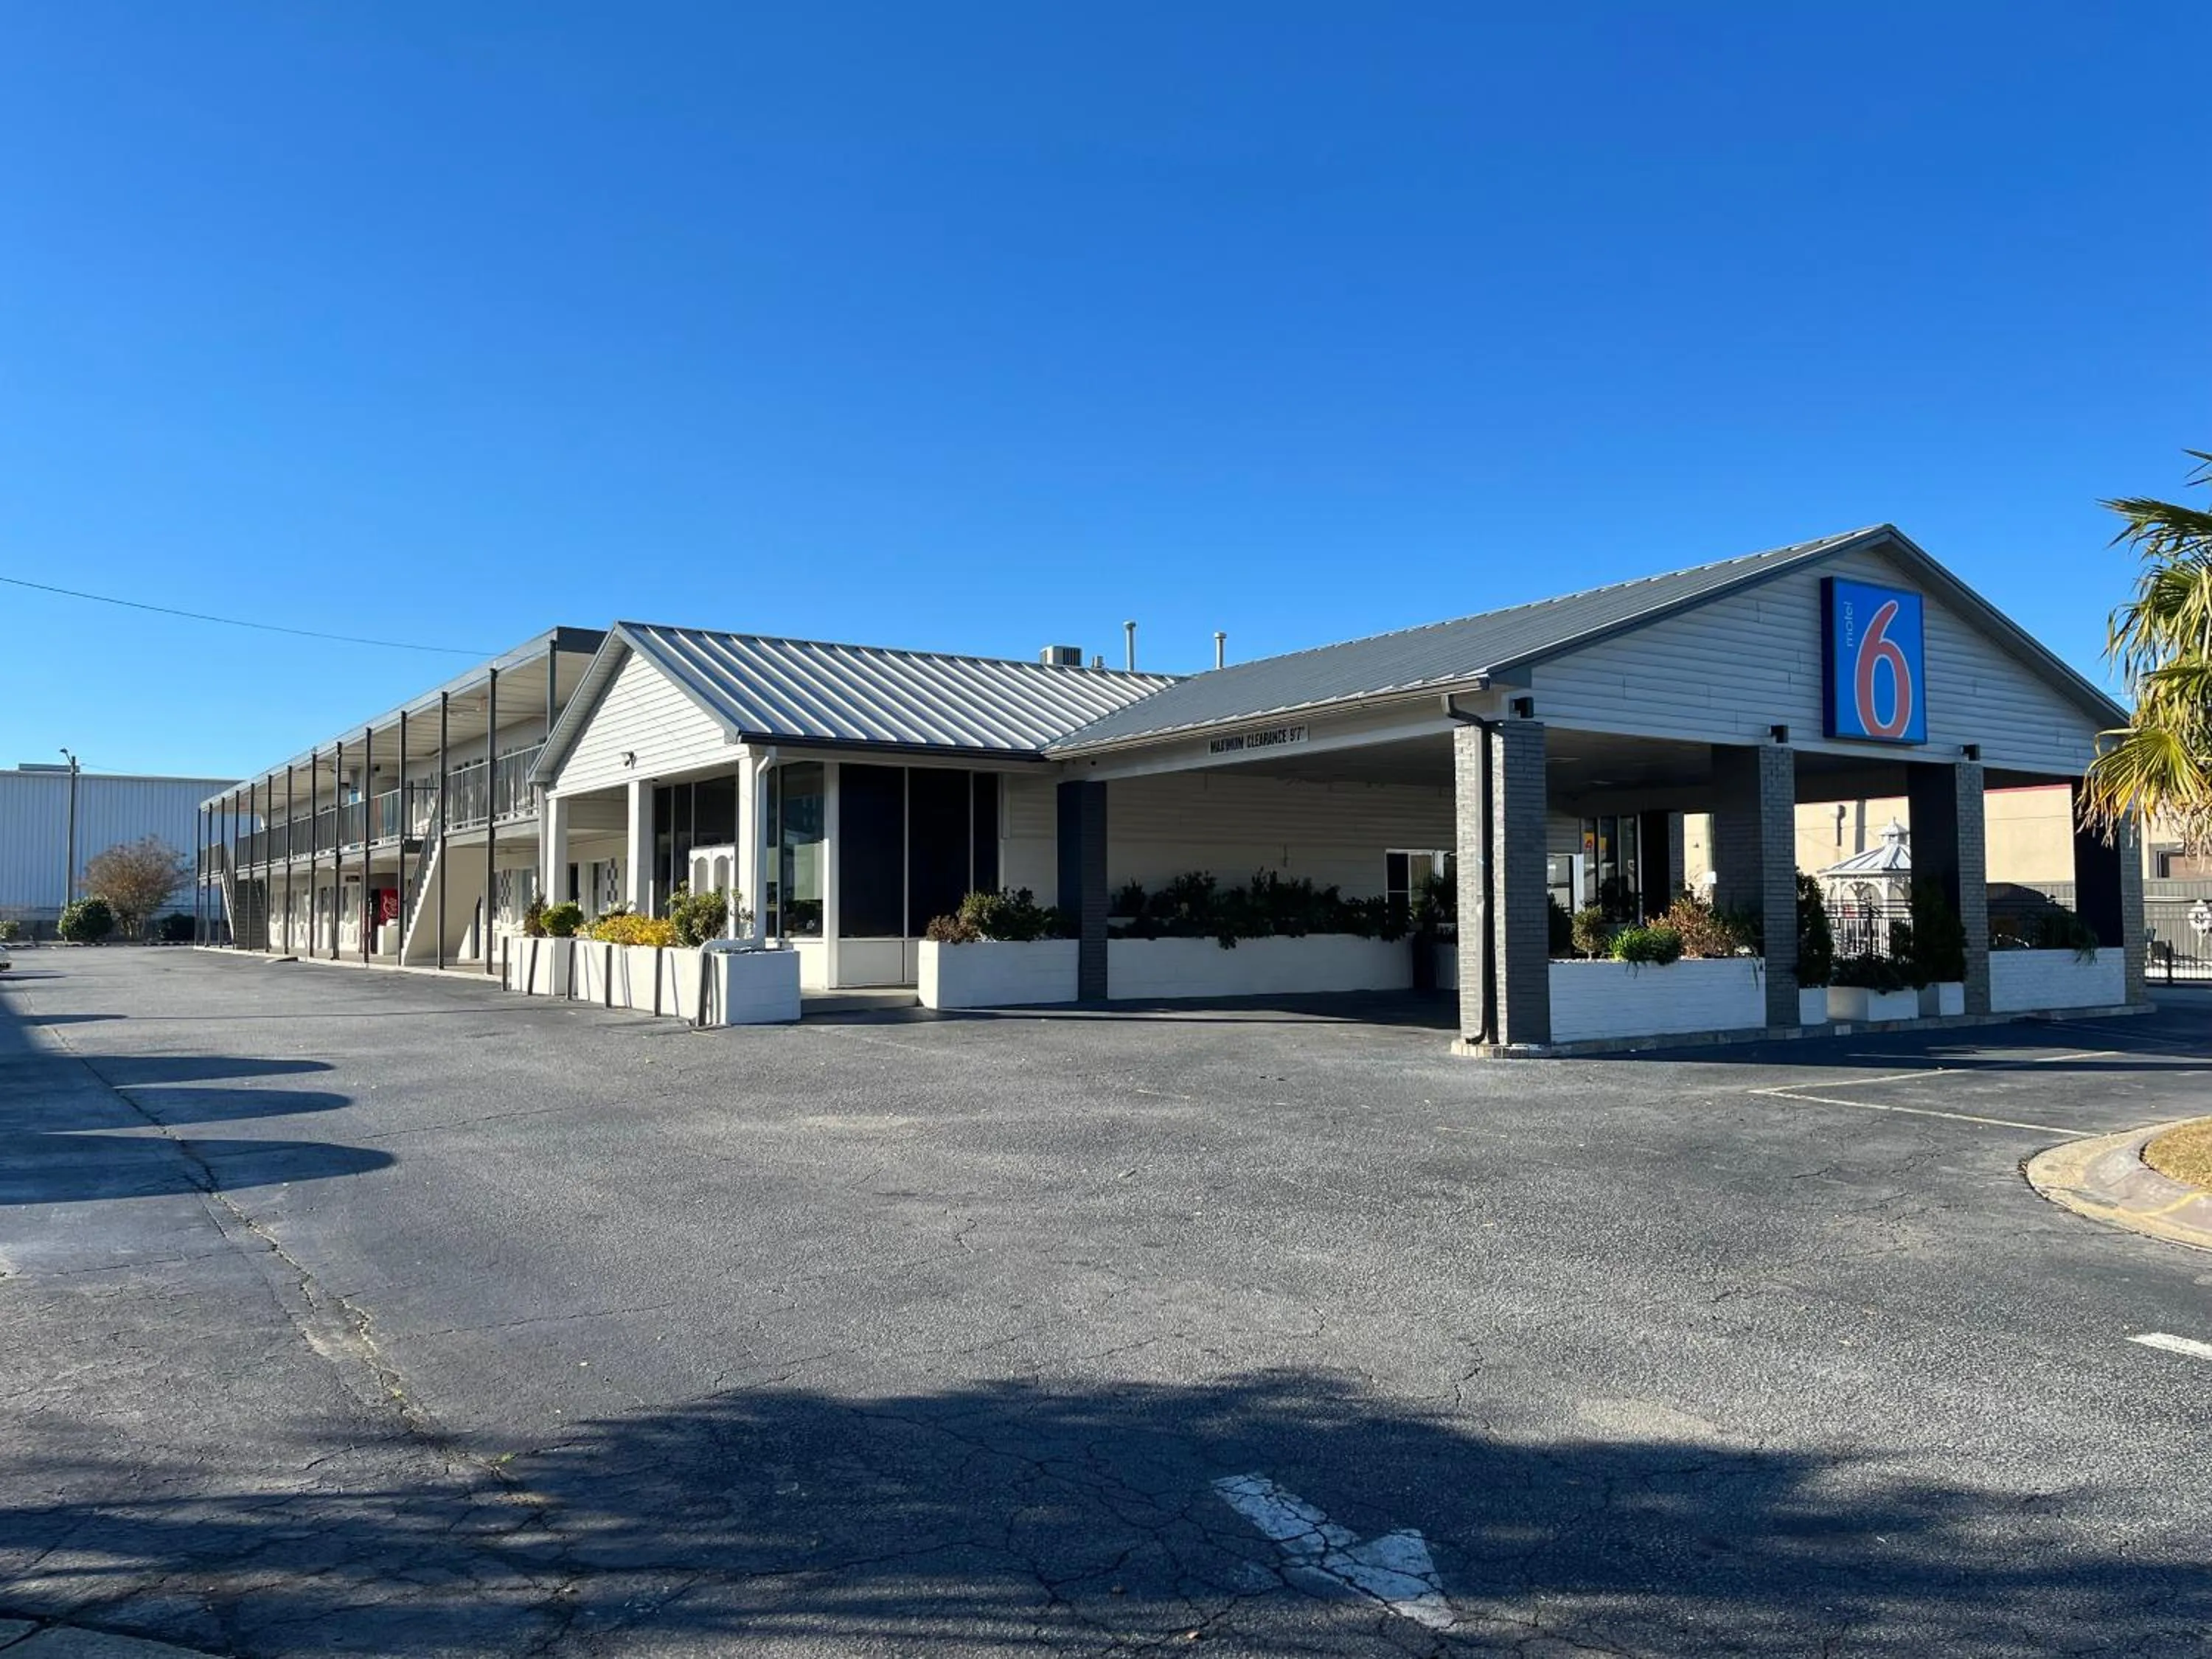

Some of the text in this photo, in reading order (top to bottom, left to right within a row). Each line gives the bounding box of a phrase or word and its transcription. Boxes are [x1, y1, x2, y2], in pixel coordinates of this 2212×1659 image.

[1843, 601, 1854, 647] motel
[1854, 599, 1912, 738] 6
[1247, 729, 1287, 748] CLEARANCE
